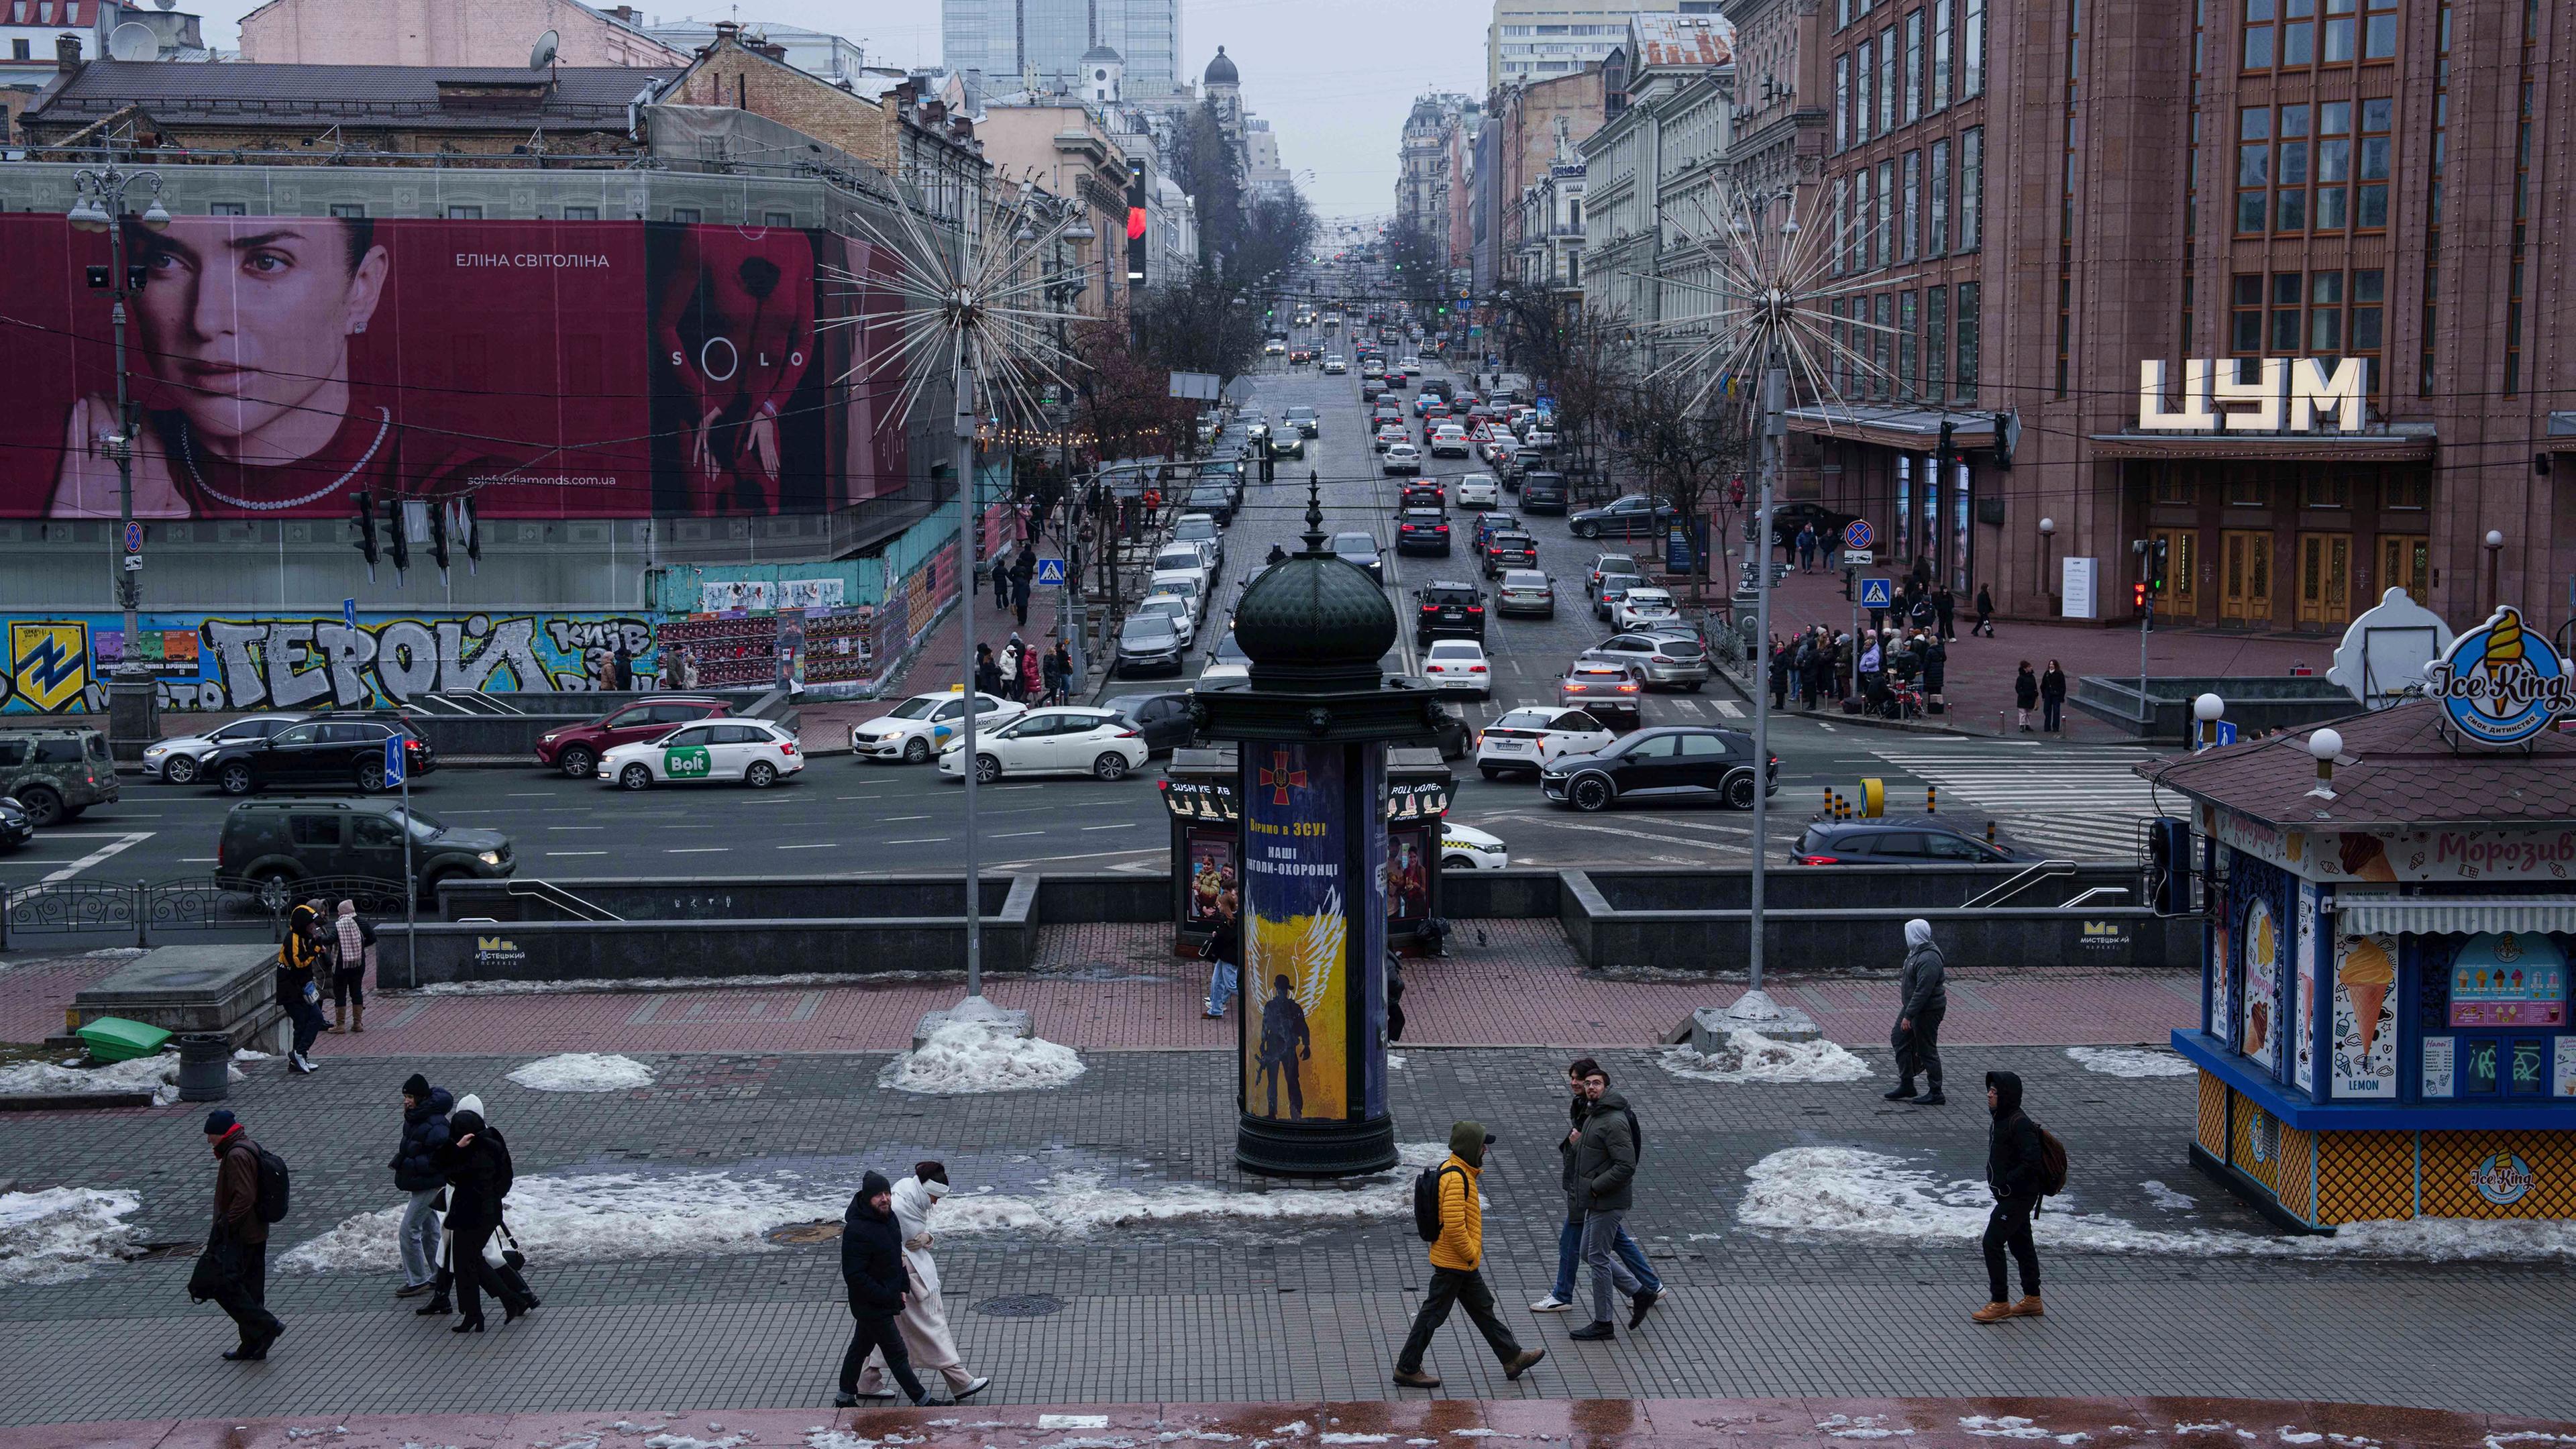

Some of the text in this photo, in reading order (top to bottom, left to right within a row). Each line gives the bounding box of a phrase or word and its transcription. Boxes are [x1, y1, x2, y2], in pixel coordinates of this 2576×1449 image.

[456, 254, 610, 268] ЕЛІНА СВІТОЛІНА
[672, 337, 803, 381] SOLO
[2139, 358, 2367, 431] ЦУМ
[467, 474, 616, 485] solofordiamonds.com.ua
[2433, 663, 2571, 710] Ice King
[2467, 714, 2536, 734] смак дитинства
[671, 755, 704, 772] Bolt
[1172, 783, 1230, 796] SUSHI KEAB
[1391, 785, 1411, 795] ROLL
[1293, 822, 1326, 837] ЗСУ!
[1267, 846, 1297, 859] НАШІ
[474, 951, 526, 959] МСТЕЦЬКИЙ
[2349, 1079, 2379, 1091] LEMON
[2471, 1169, 2535, 1190] Ice King
